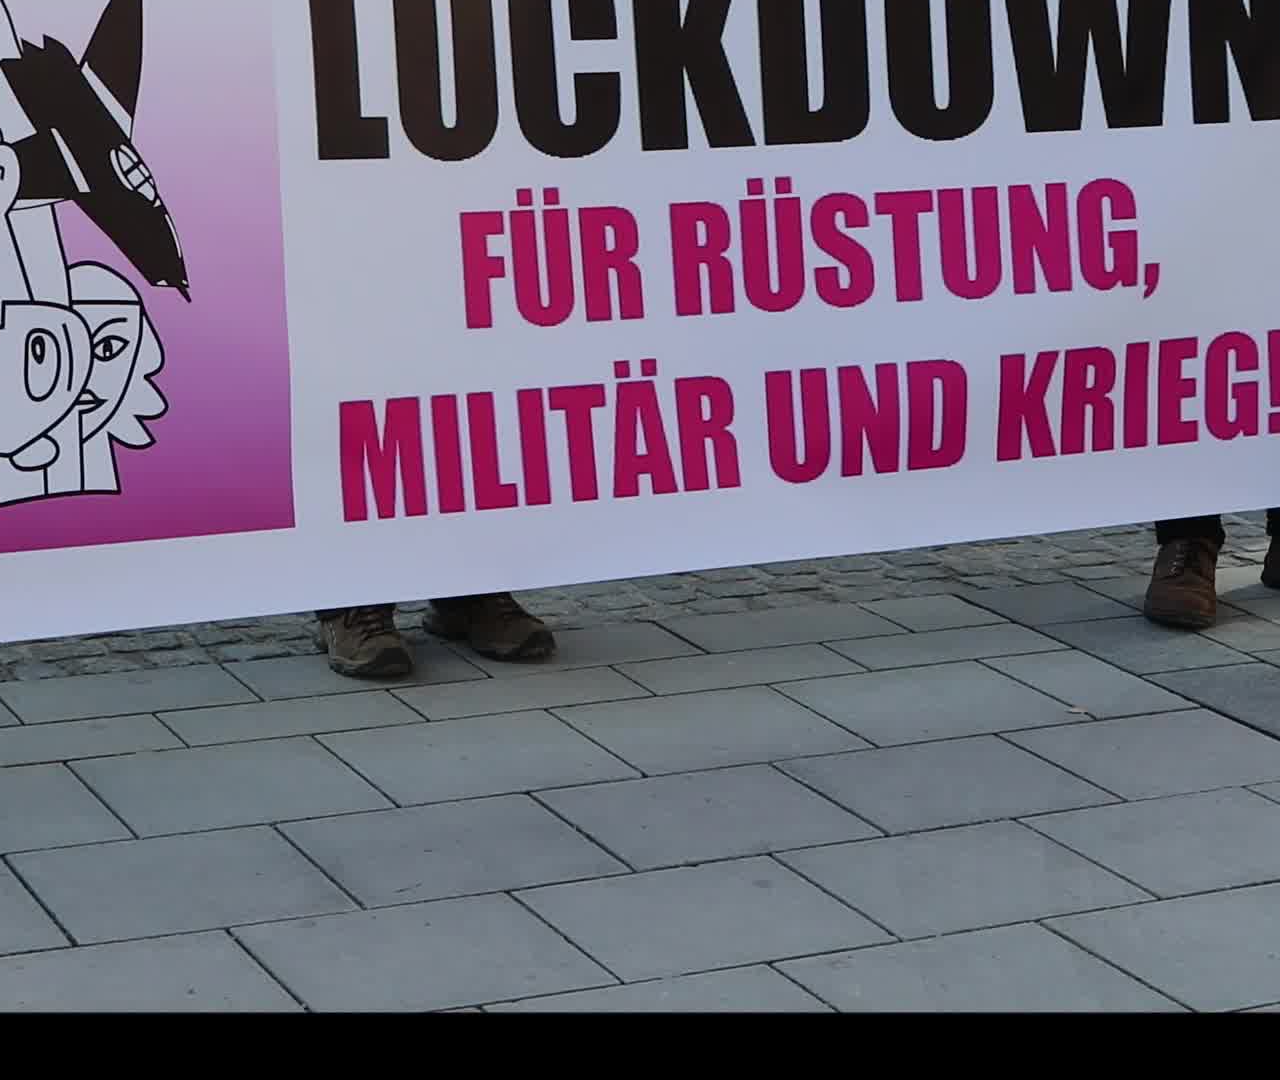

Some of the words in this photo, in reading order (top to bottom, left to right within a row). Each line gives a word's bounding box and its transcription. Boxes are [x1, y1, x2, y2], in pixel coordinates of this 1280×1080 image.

[458, 185, 645, 330] FÜR
[668, 175, 1161, 317] RÜSTUNG,
[338, 357, 742, 522] MILITÄR
[763, 358, 969, 485] UND
